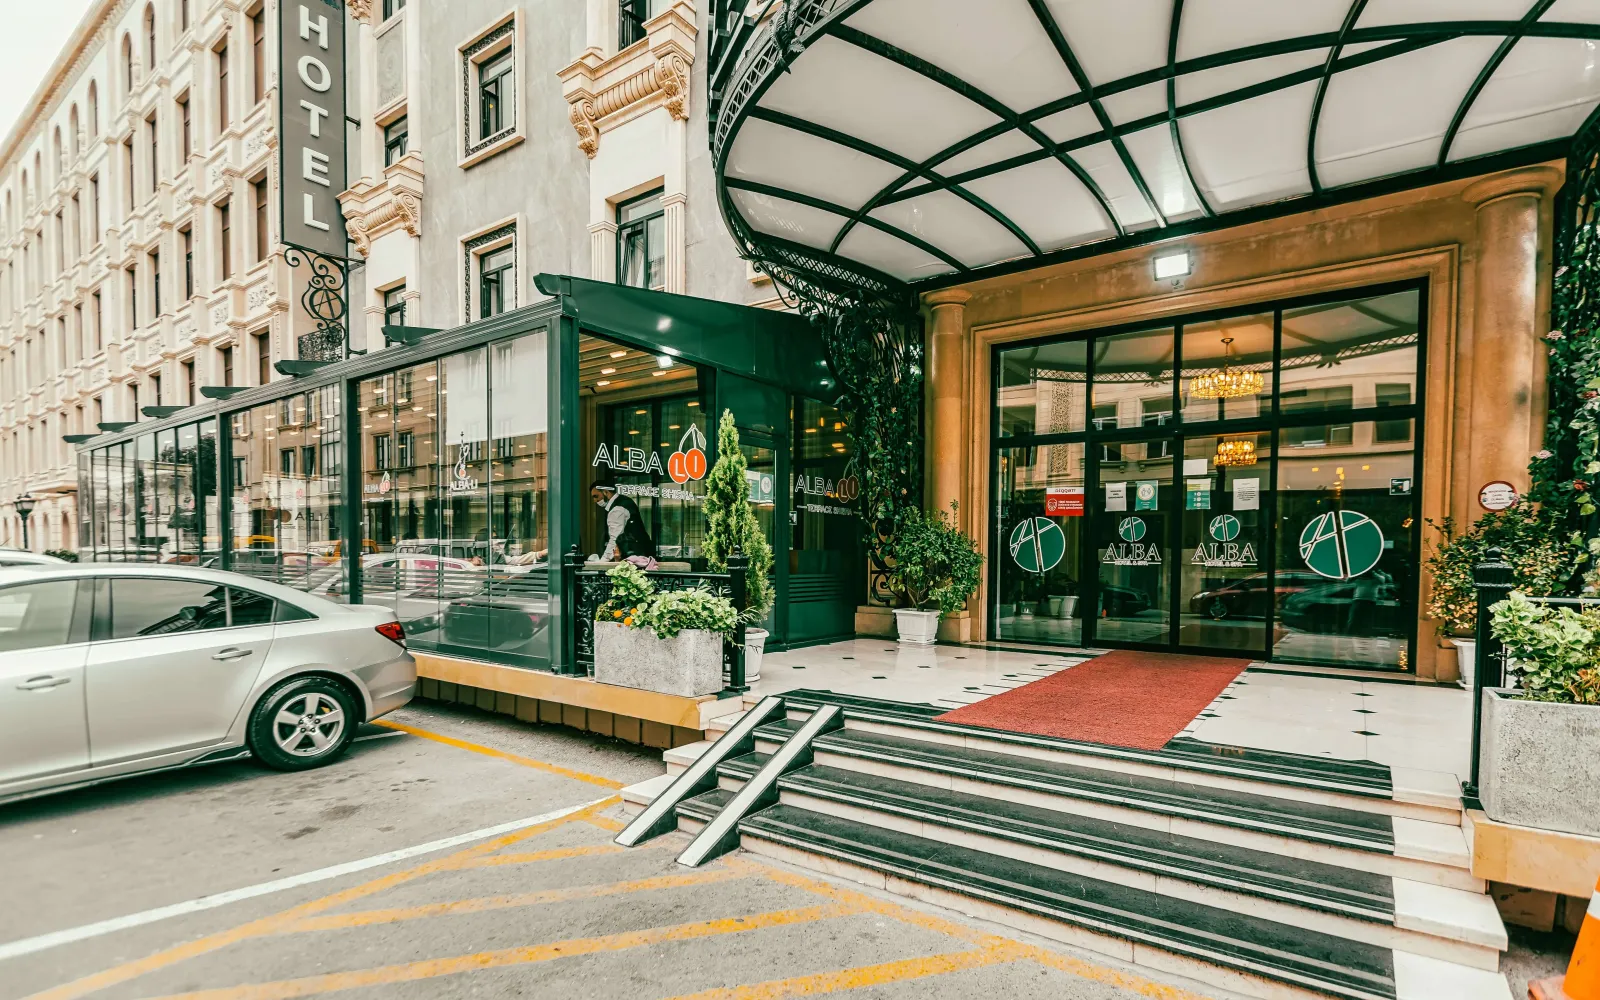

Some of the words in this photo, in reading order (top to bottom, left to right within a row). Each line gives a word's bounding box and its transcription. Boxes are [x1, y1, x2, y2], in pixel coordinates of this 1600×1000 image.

[298, 5, 331, 231] HOTEL
[592, 443, 664, 475] ALBA
[615, 484, 660, 498] TERRACE
[795, 474, 835, 496] ALBA
[1103, 543, 1162, 561] ALBA
[1191, 542, 1258, 561] ALBA
